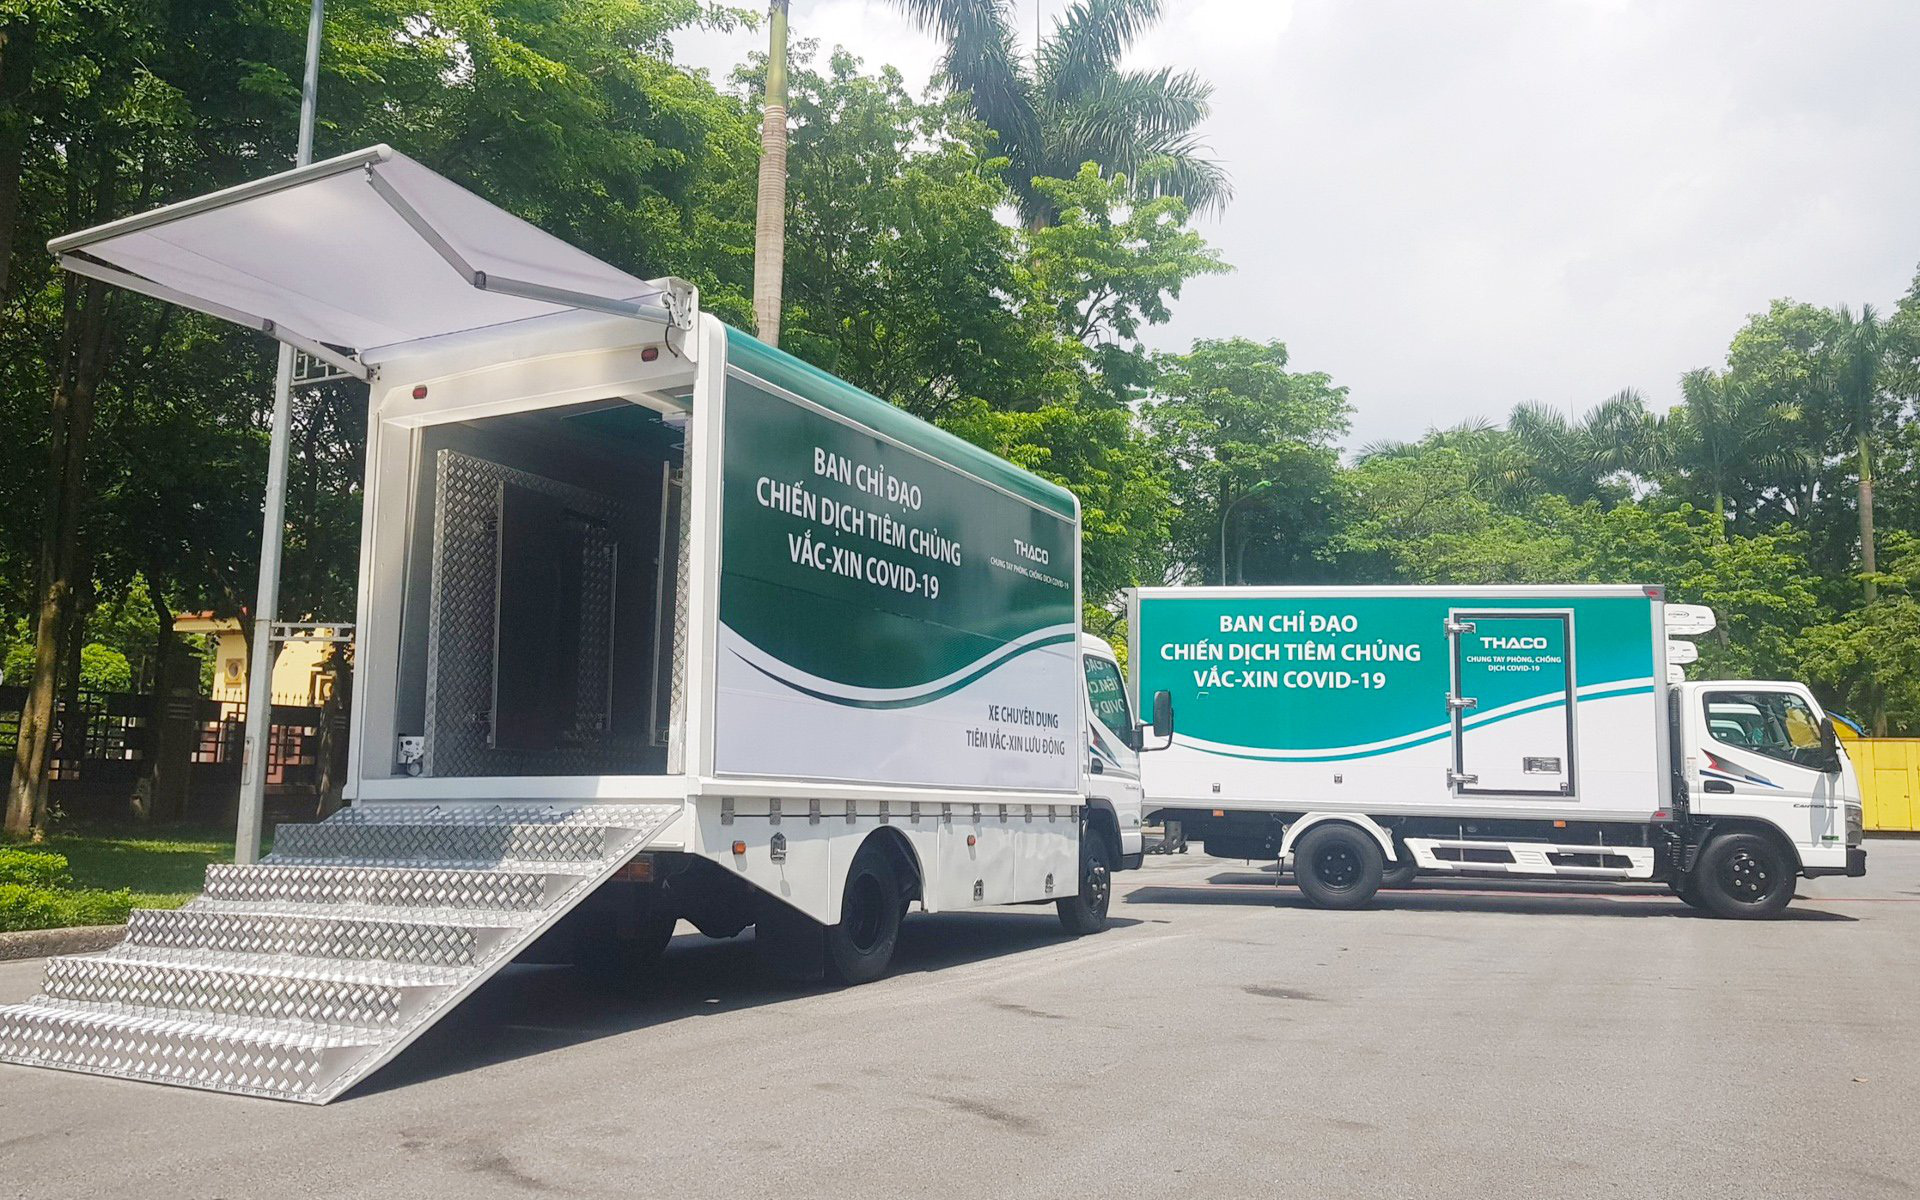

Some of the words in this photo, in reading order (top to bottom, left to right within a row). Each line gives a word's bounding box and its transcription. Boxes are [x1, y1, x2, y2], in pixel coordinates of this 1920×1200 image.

[814, 447, 851, 485] BAN
[855, 464, 884, 497] CHỈ
[887, 476, 922, 513] ĐẠO
[756, 477, 816, 521] CHIẾN
[821, 497, 864, 536] DỊCH
[867, 513, 906, 549] TIÊM
[909, 527, 961, 566] CHỦNG
[788, 529, 862, 580] VẮC-XIN
[866, 557, 939, 599] COVID-19
[1014, 539, 1049, 565] THACO
[1219, 614, 1264, 633] BAN
[1268, 610, 1305, 633] CHỈ
[1309, 614, 1358, 637] ĐẠO
[1160, 639, 1223, 661] CHIẾN
[1228, 643, 1280, 665] DỊCH
[1283, 640, 1336, 661] TIÊM
[1341, 639, 1421, 662] CHỦNG
[1479, 637, 1547, 649] THACO
[1466, 655, 1492, 663] CHUNG
[1493, 655, 1505, 663] TAY
[1193, 665, 1278, 688] VẮC-XIN
[1283, 670, 1386, 690] COVID-19
[988, 704, 1000, 722] XE
[1001, 706, 1034, 726] CHUYÊN
[1036, 711, 1059, 732] DỤNG
[966, 727, 988, 749] TIÊM
[989, 728, 1023, 752] VẮC-XIN
[1024, 735, 1041, 754] LƯU
[1042, 736, 1065, 759] ĐỘNG
